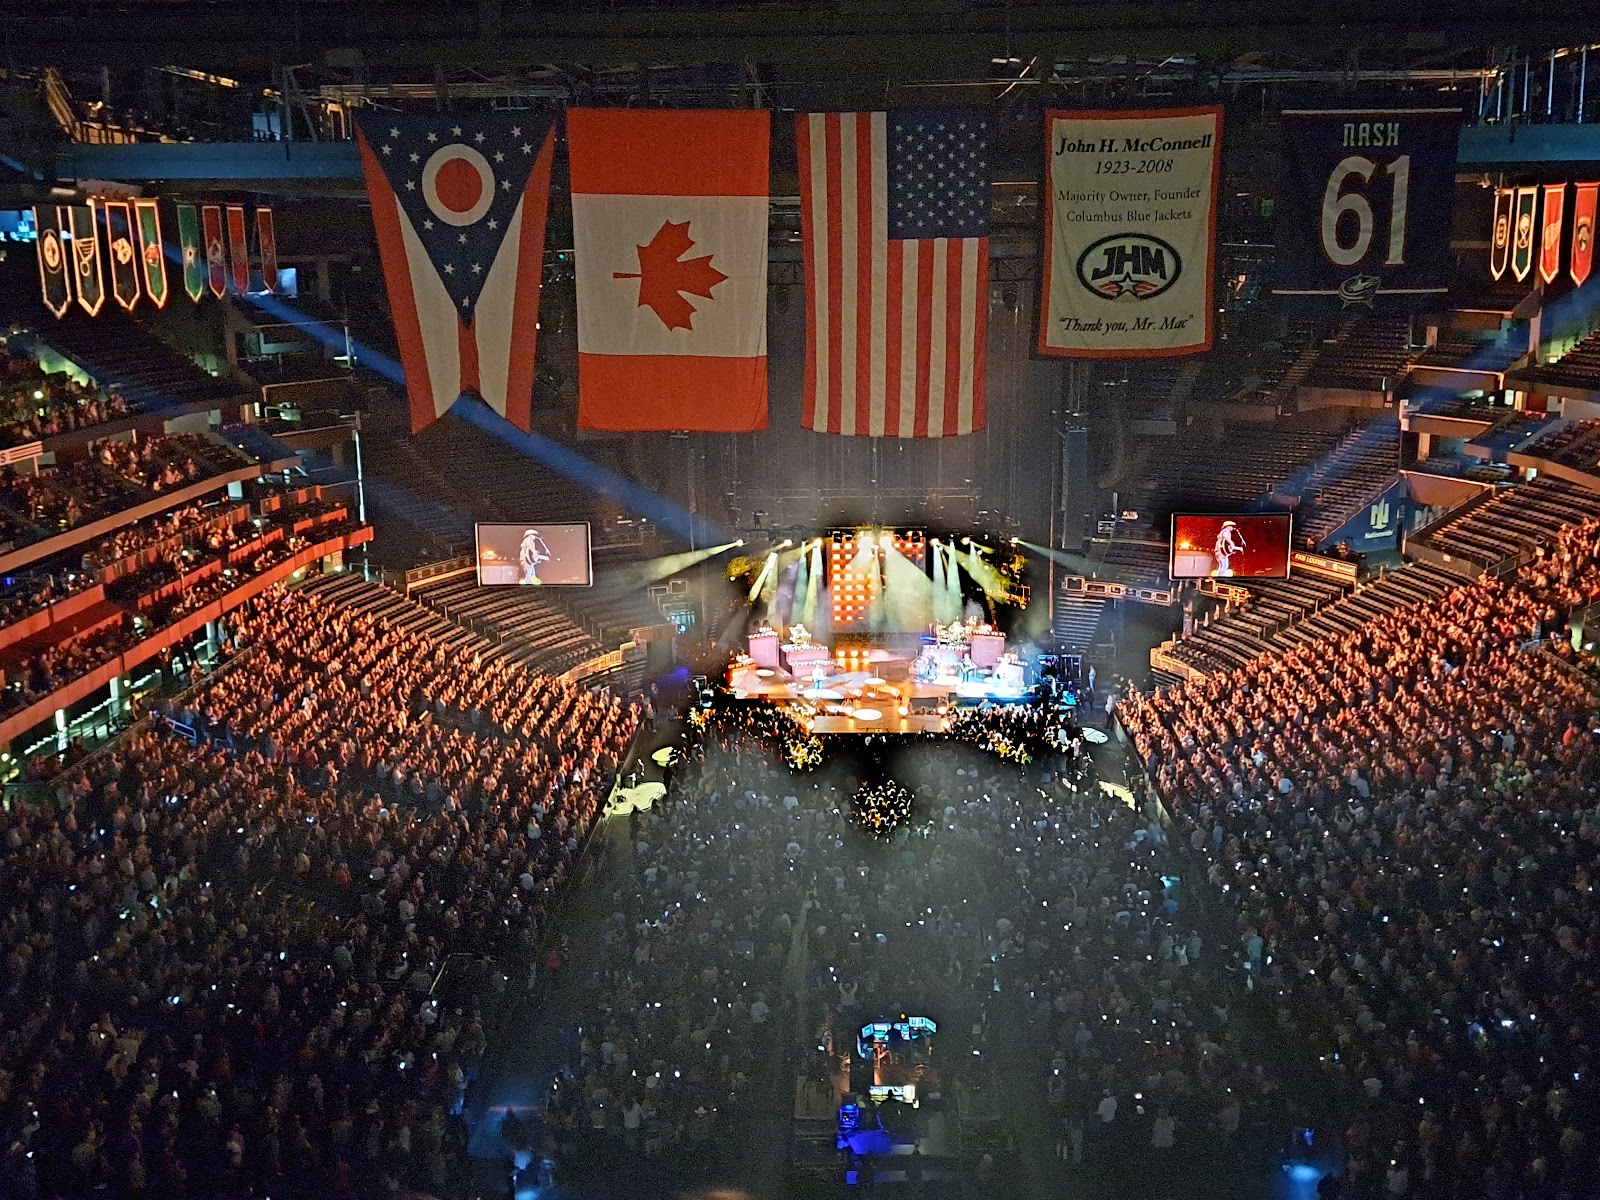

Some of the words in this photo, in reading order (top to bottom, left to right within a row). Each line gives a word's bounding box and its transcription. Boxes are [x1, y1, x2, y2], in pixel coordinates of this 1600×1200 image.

[1056, 138, 1095, 156] John
[1099, 138, 1119, 153] H.
[1122, 133, 1213, 152] McConnell
[1343, 123, 1400, 147] NASH
[1095, 159, 1174, 174] 1923-2008
[1058, 190, 1107, 204] Majority
[1109, 190, 1150, 203] Owner,
[1154, 188, 1201, 200] Founder
[1066, 210, 1123, 222] Columbus
[1126, 210, 1151, 221] Blue
[1154, 209, 1192, 222] Jackets
[1321, 155, 1411, 265] 61
[1091, 245, 1168, 281] JHM
[1102, 321, 1129, 336] you,
[1131, 317, 1156, 331] Mr.
